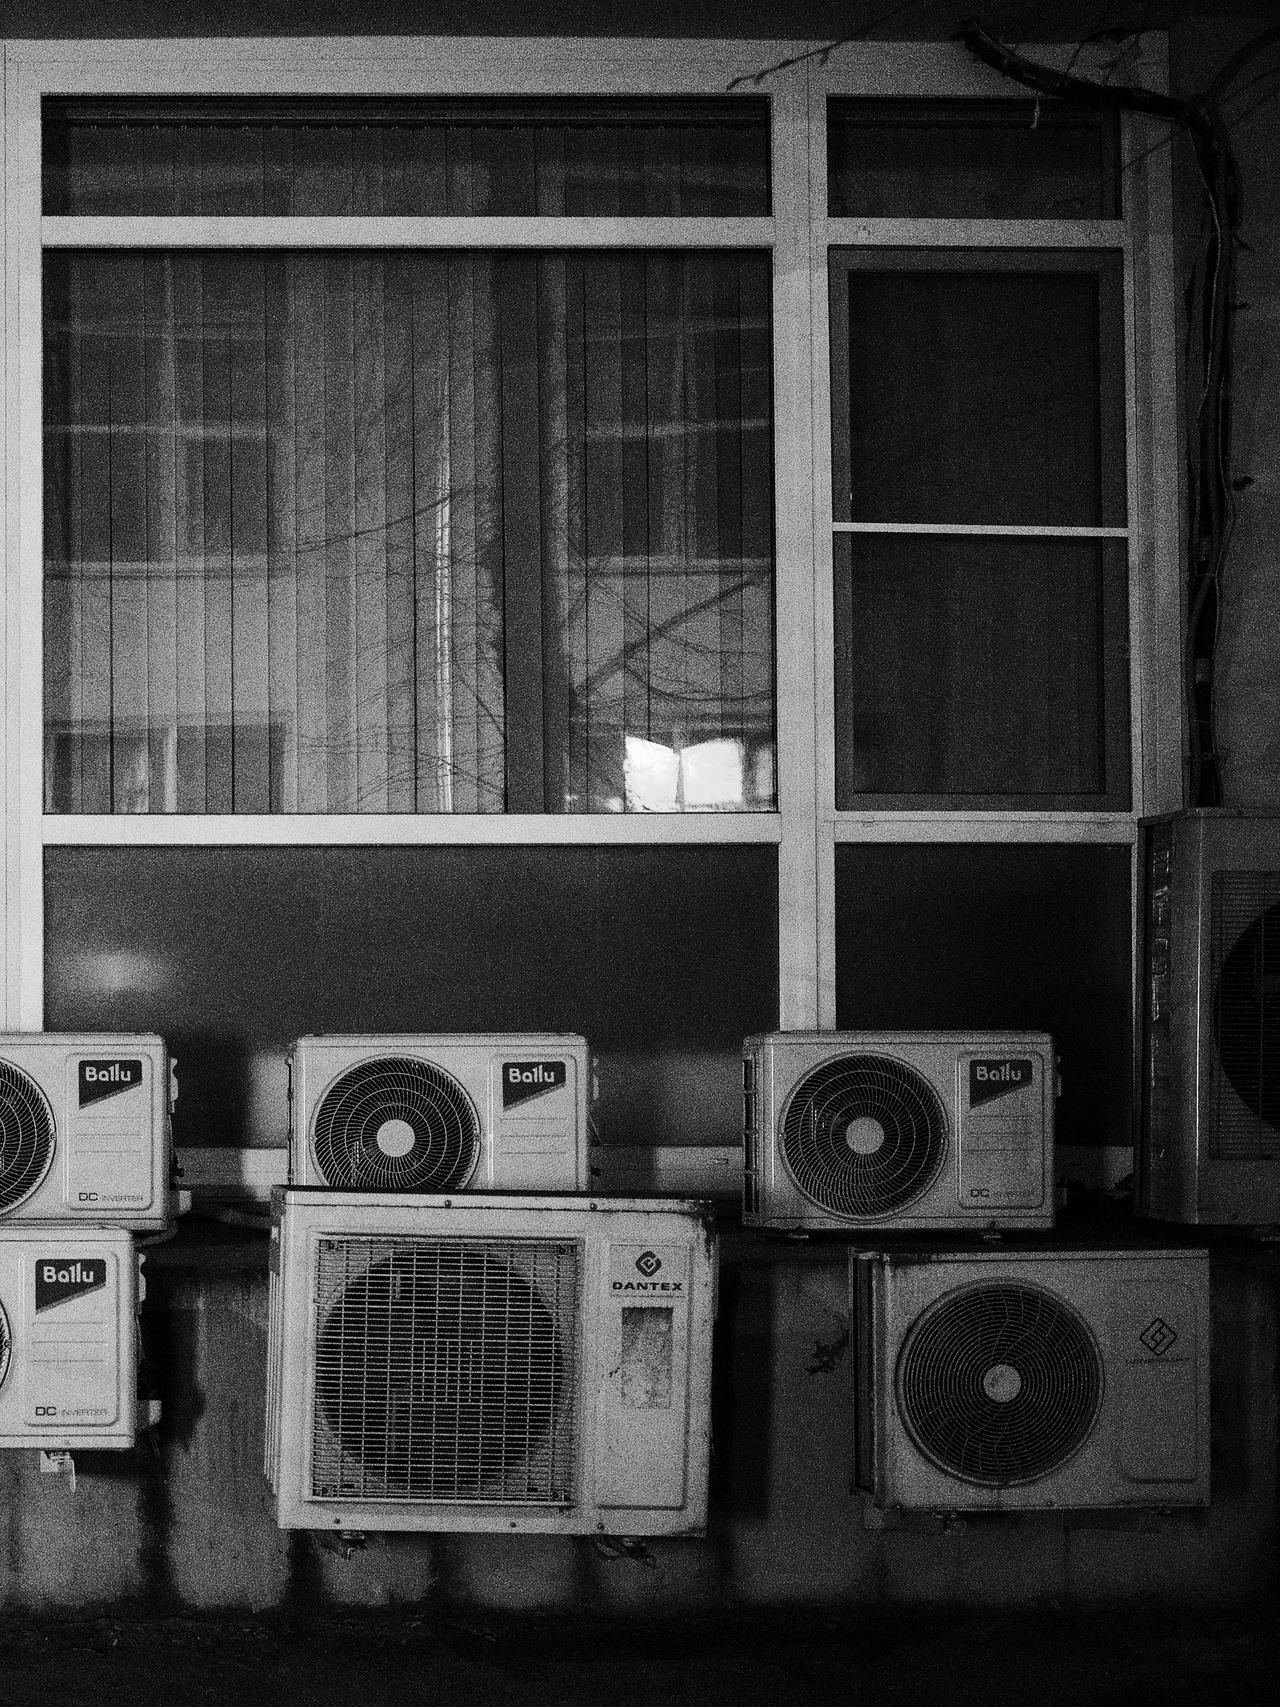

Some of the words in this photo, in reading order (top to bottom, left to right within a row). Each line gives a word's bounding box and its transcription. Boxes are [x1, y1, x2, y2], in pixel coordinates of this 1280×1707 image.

[85, 1063, 131, 1082] Ballu
[509, 1064, 555, 1083] Ballu
[976, 1062, 1022, 1081] Ballu
[79, 1192, 98, 1201] DC
[970, 1188, 990, 1198] DC
[43, 1262, 94, 1283] Ballu
[612, 1281, 683, 1291] DANTEX
[35, 1406, 57, 1416] DC
